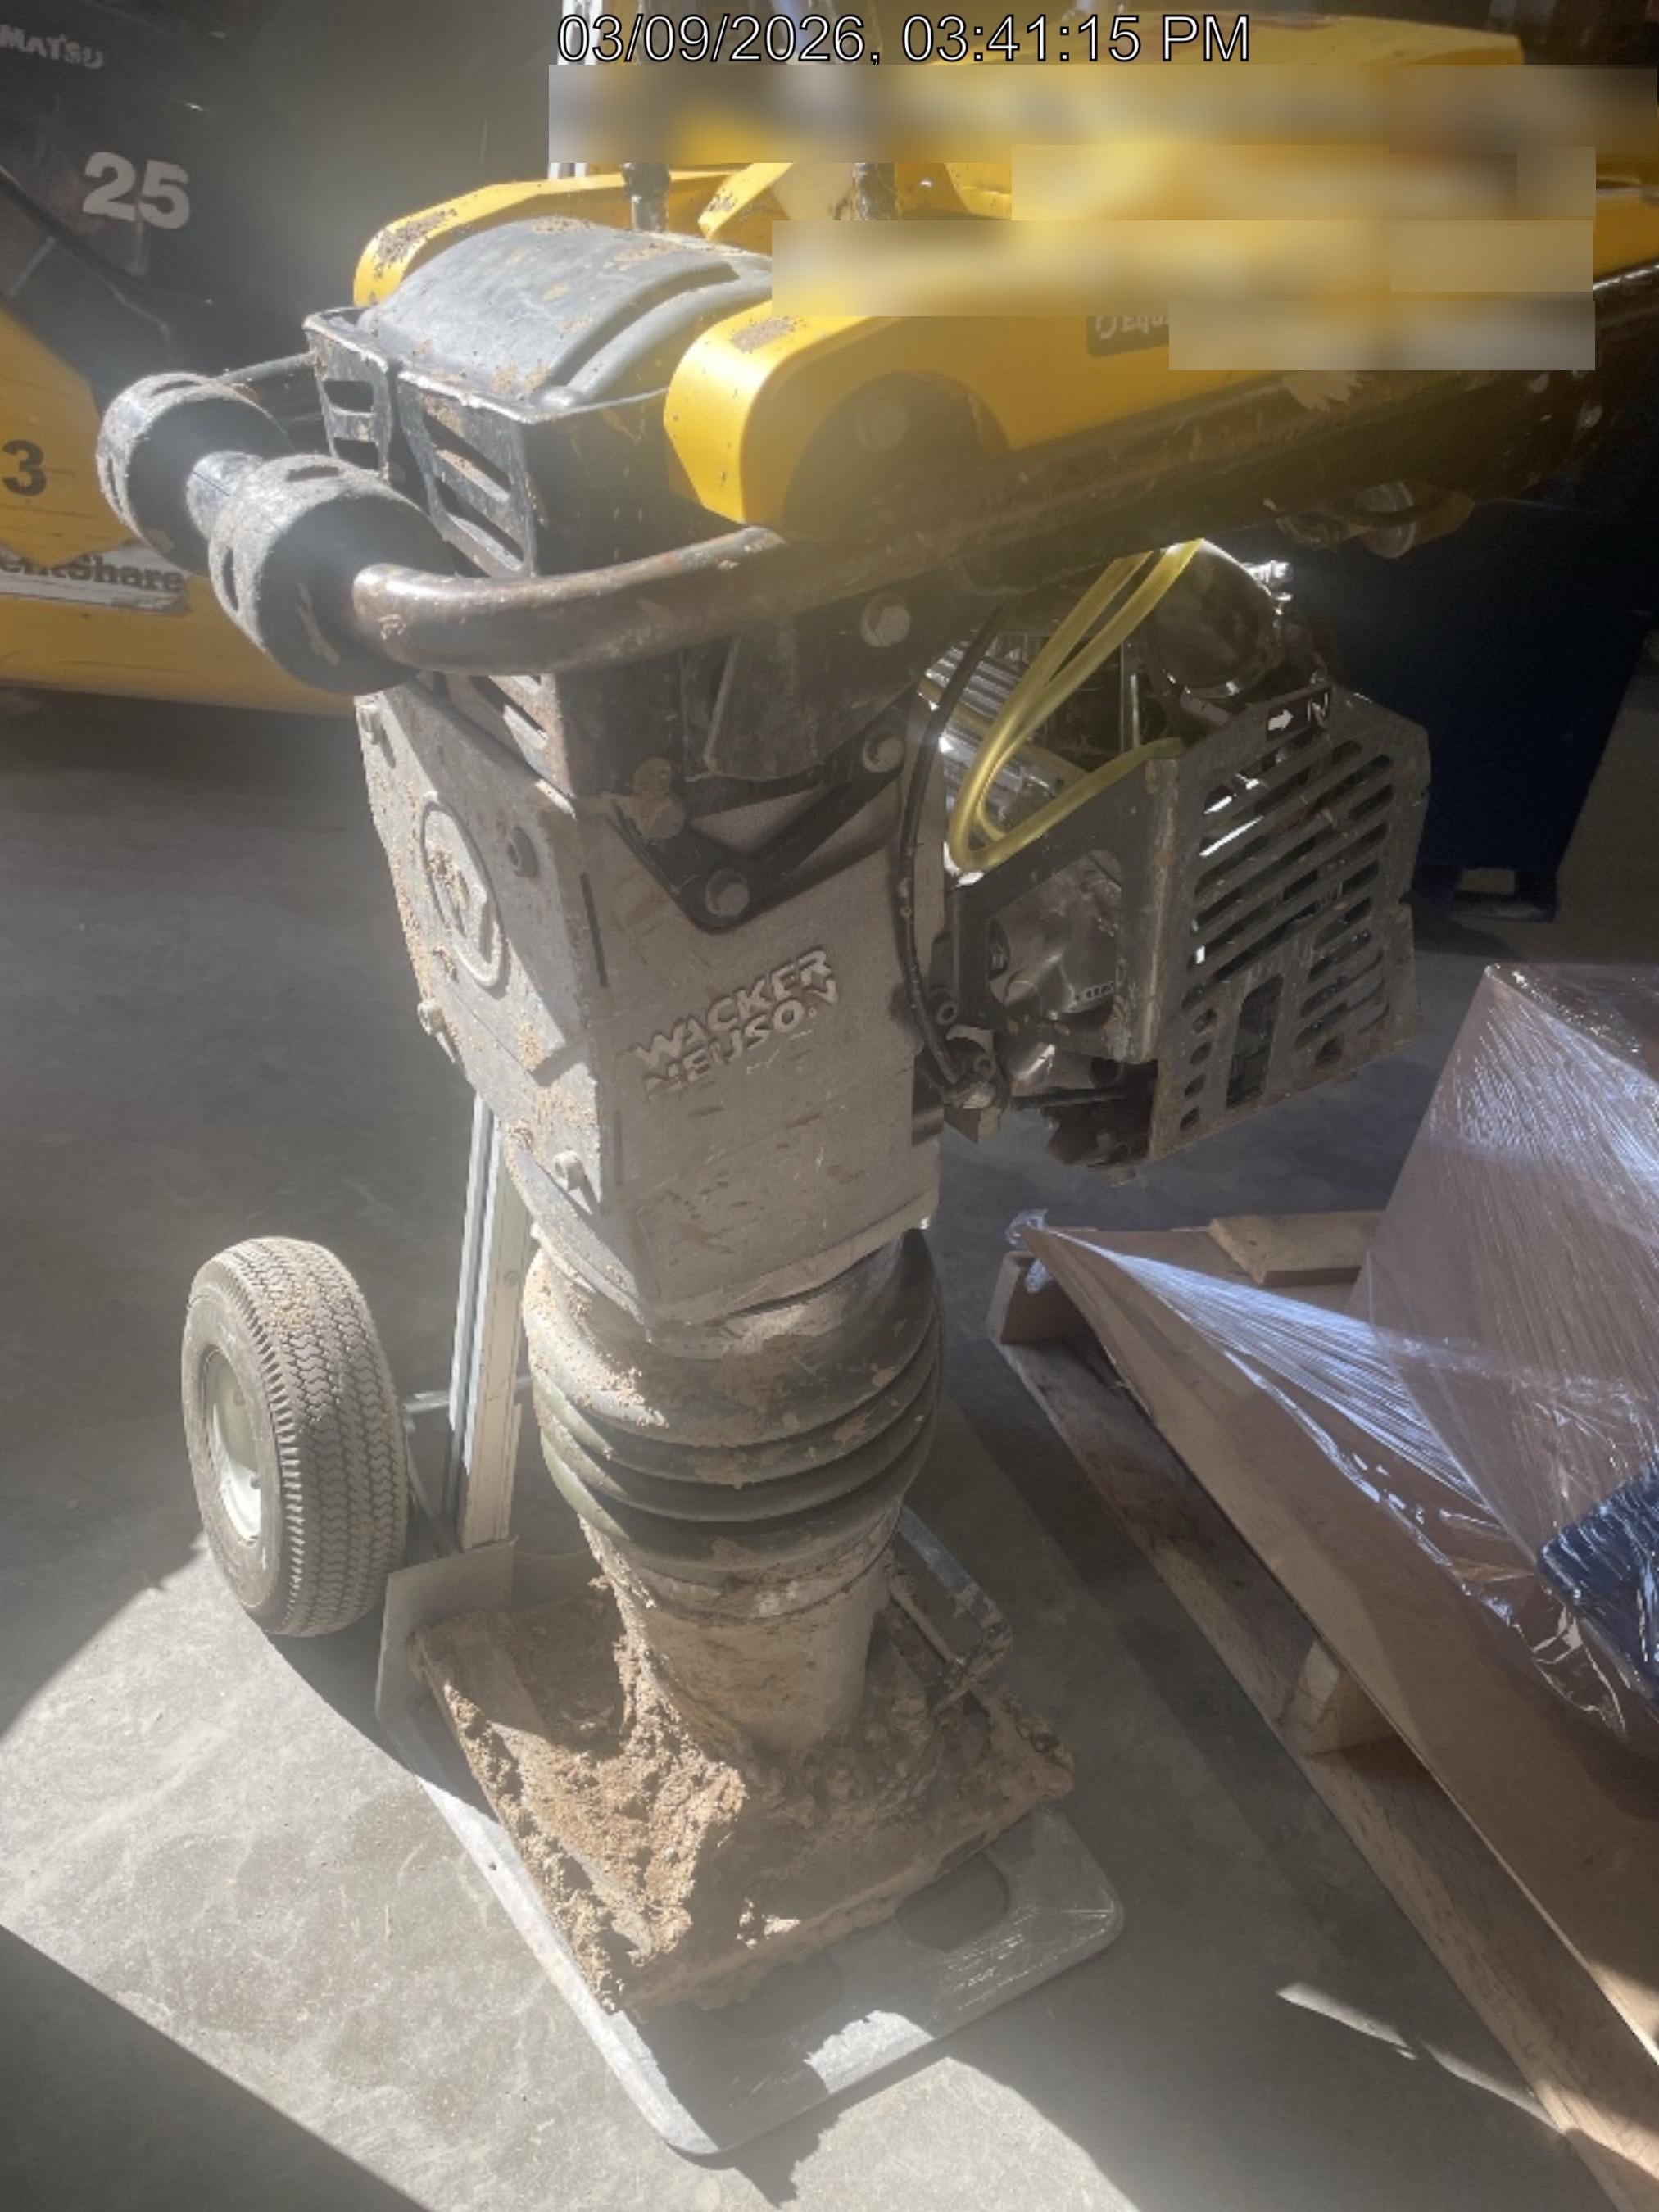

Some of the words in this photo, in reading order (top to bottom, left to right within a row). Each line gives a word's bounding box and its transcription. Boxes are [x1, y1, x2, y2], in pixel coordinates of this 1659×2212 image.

[83, 152, 191, 229] 25
[2, 439, 47, 496] 3
[625, 945, 833, 1068] WACKER
